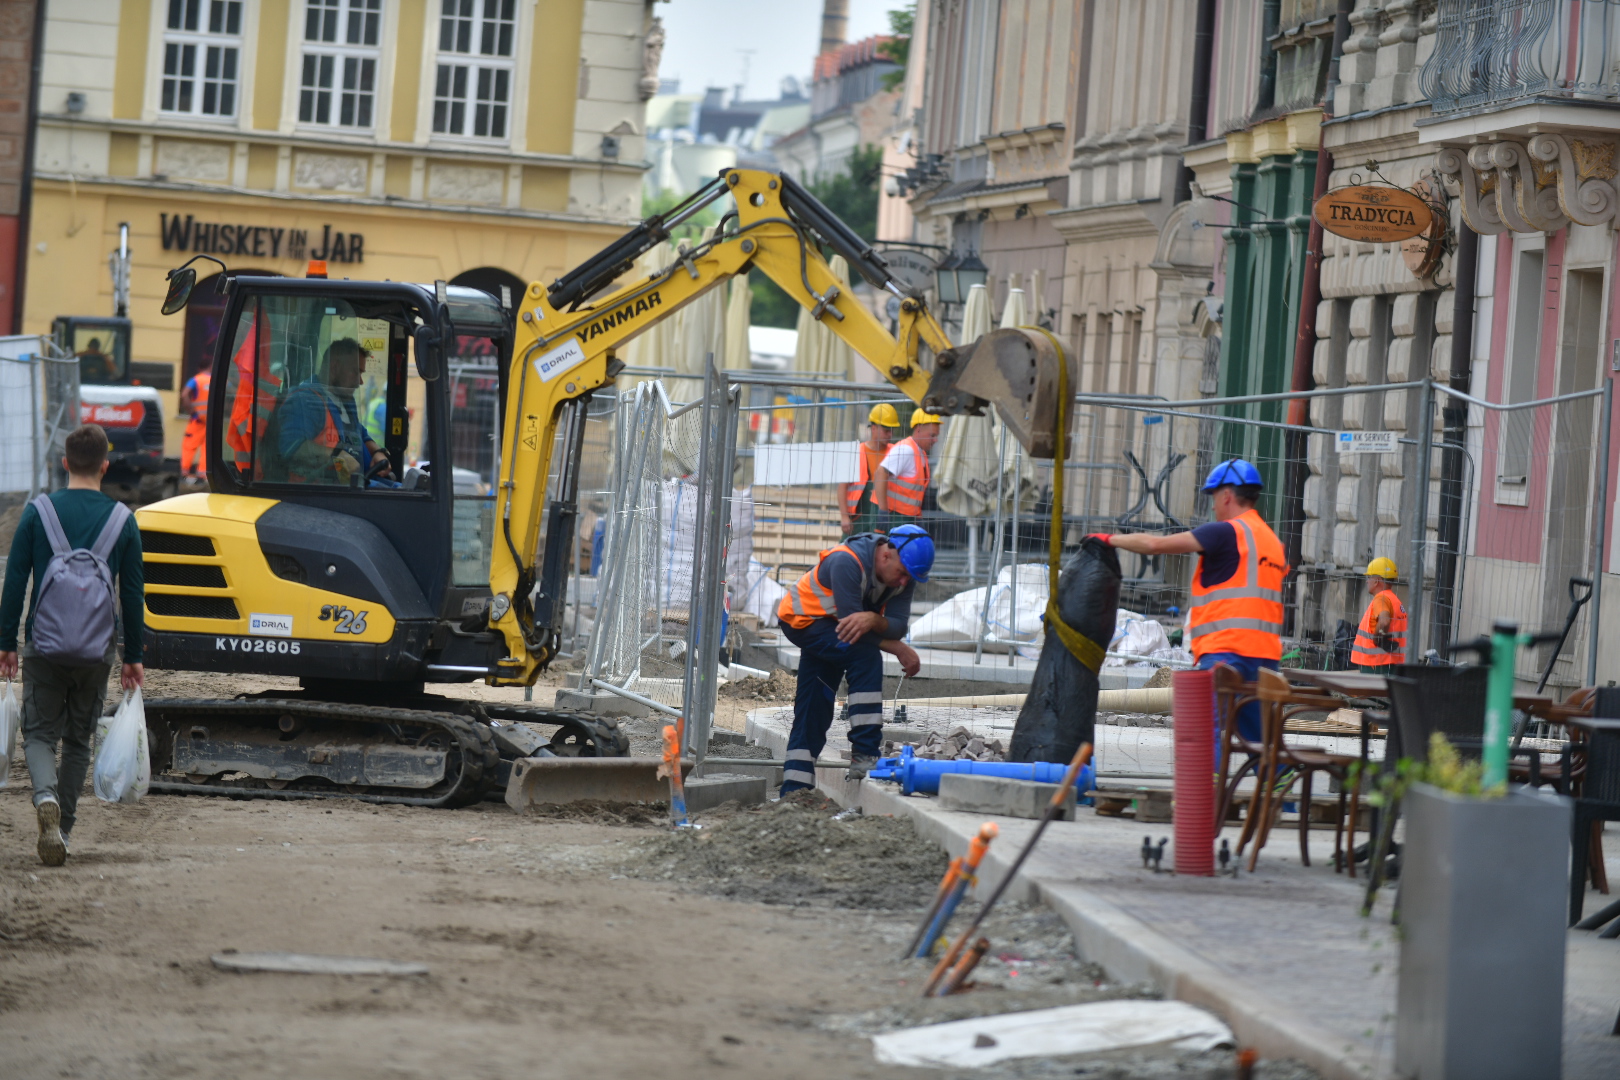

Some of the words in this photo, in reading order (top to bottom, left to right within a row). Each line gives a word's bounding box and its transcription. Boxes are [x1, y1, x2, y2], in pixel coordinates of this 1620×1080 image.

[1329, 204, 1416, 226] TRADYCJA
[160, 213, 285, 258] WHISKEY
[289, 228, 307, 247] IN
[311, 223, 364, 263] JAR
[1354, 224, 1390, 232] GOŚCINIEC
[887, 255, 934, 277] uliwer
[576, 291, 662, 343] YANMAR
[549, 349, 577, 368] DRIAL
[1353, 433, 1363, 442] KK
[1364, 433, 1391, 442] SERVICE
[261, 621, 289, 629] DRIAL
